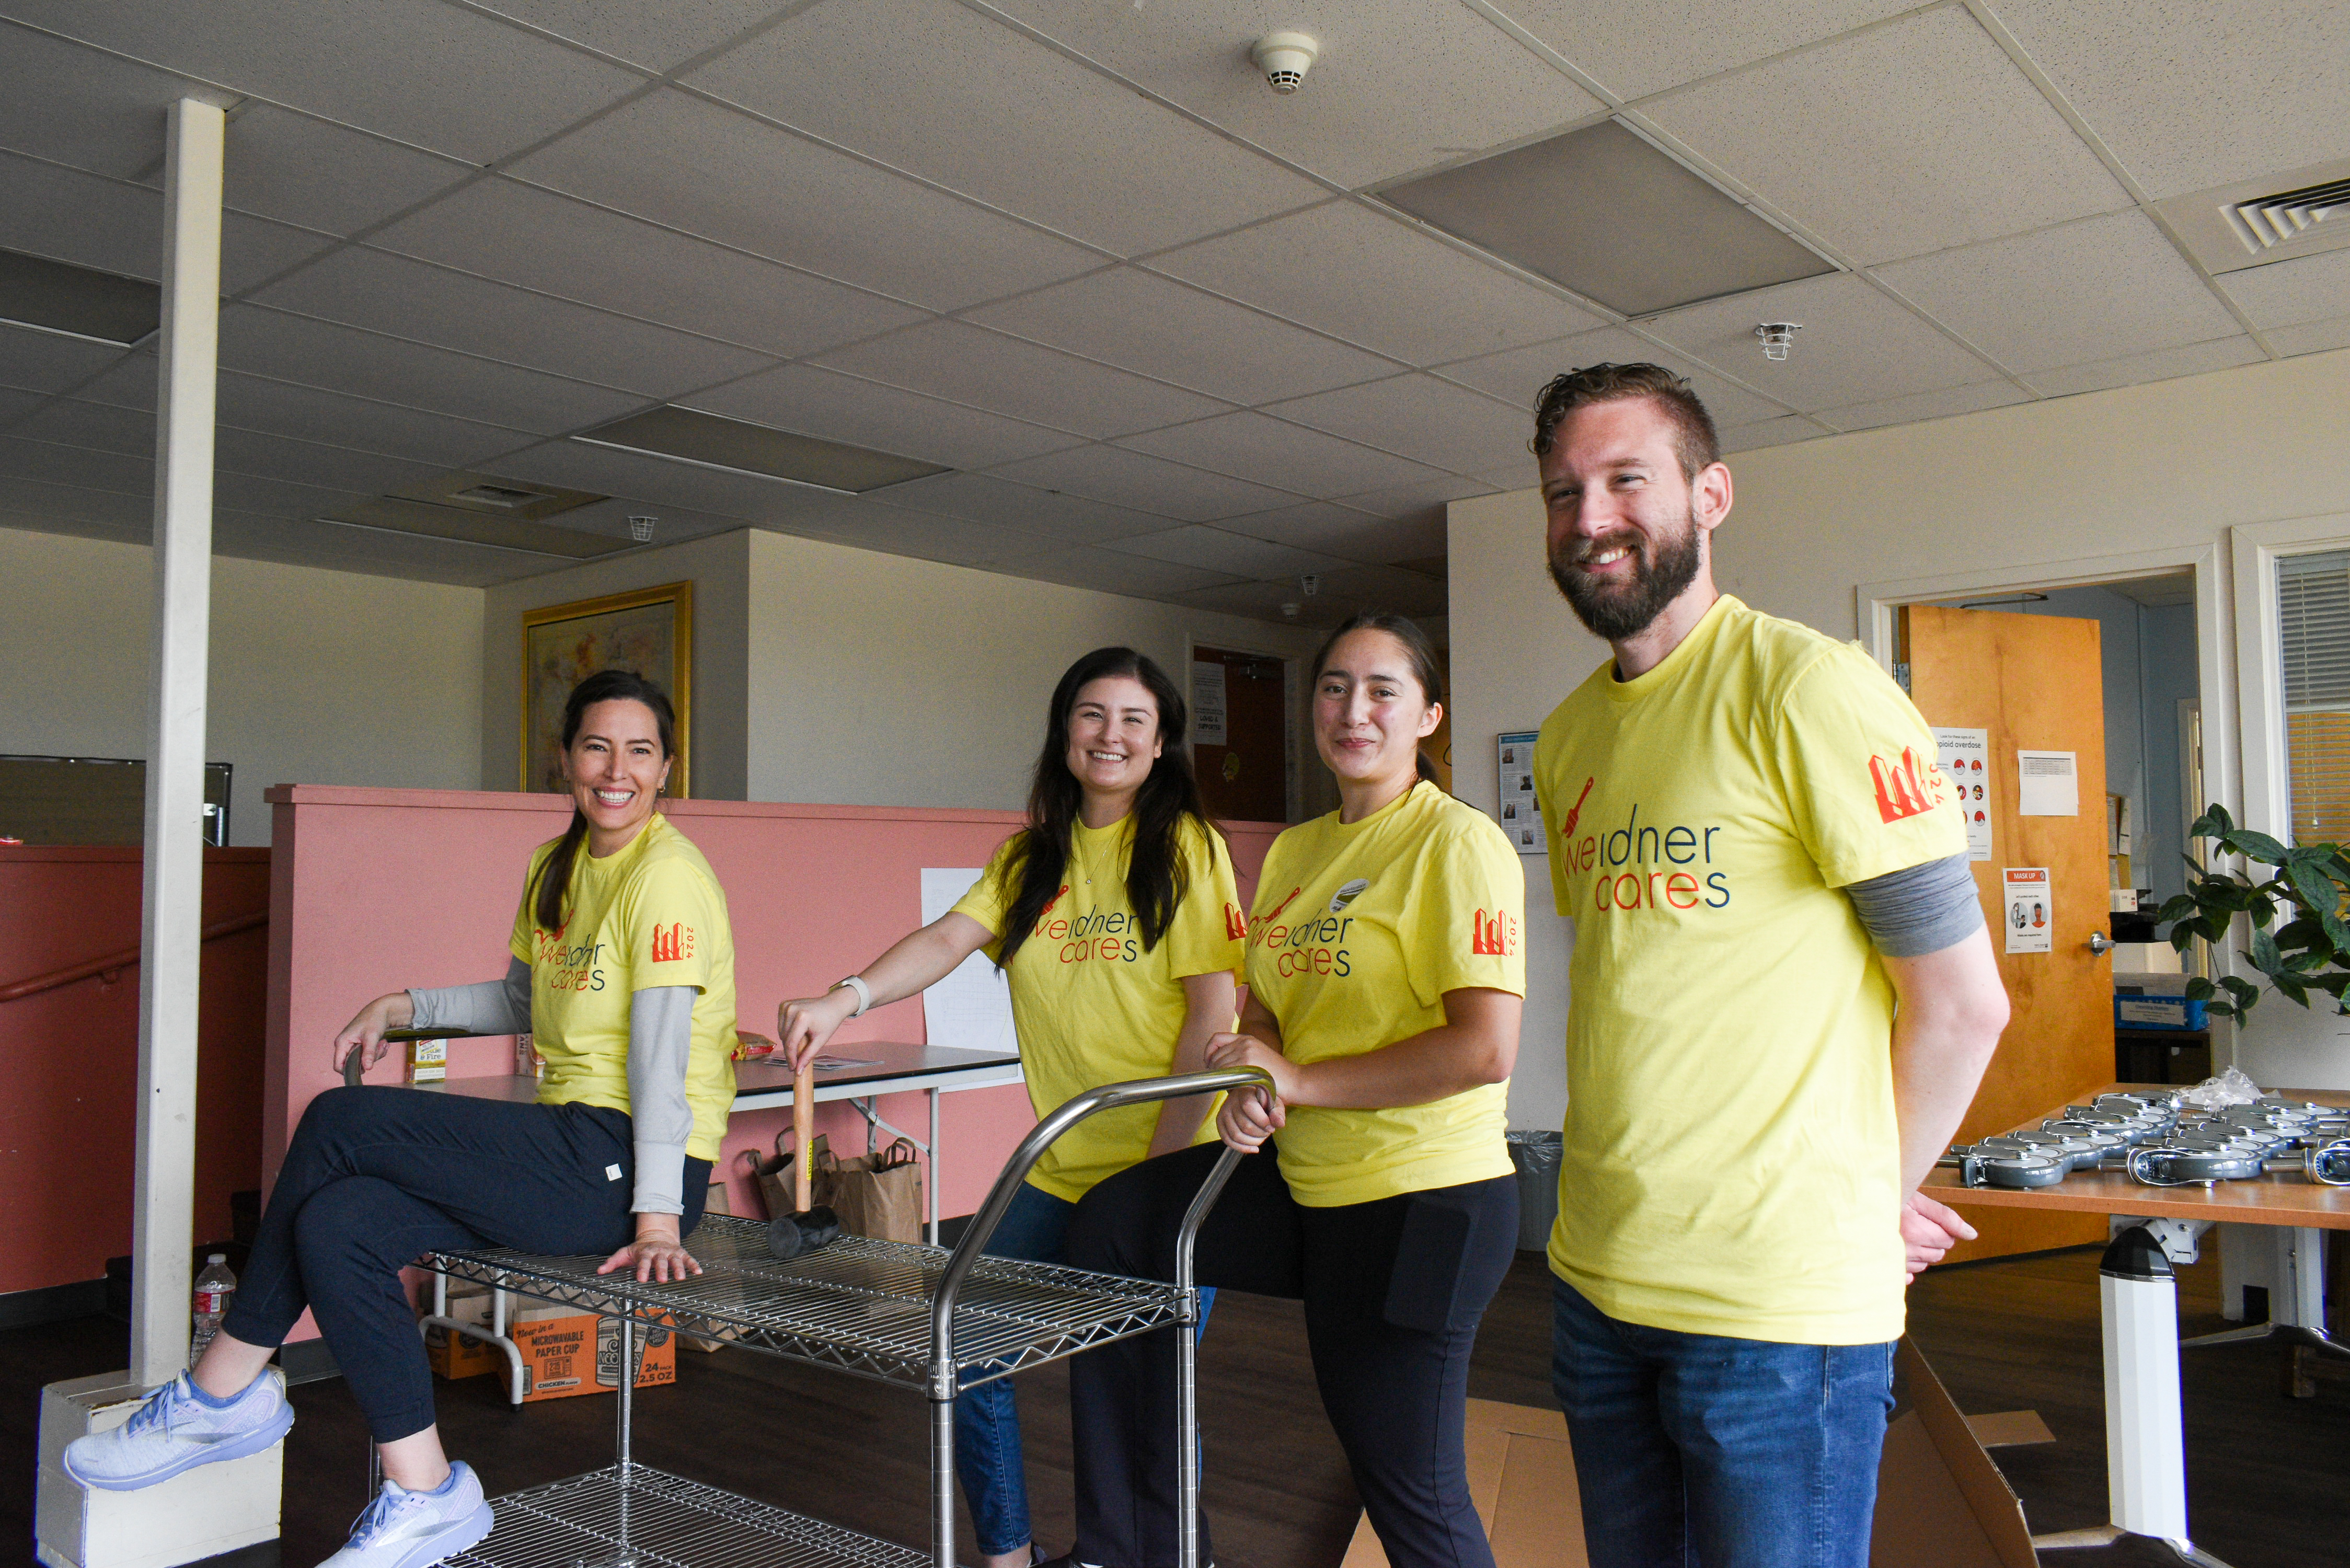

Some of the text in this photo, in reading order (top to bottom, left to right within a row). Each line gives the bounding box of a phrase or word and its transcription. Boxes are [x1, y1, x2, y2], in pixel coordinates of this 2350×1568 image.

[1929, 763, 1944, 805] 024
[1562, 804, 1721, 879] weidner
[1596, 872, 1730, 912] cares
[1059, 938, 1137, 963] cares
[1278, 948, 1351, 978] cares
[517, 1328, 537, 1339] Now
[538, 1325, 546, 1333] in
[532, 1331, 584, 1347] MICROWAVABLE
[536, 1344, 580, 1358] PAPER CUP
[646, 1363, 659, 1372] 24
[538, 1380, 565, 1389] CHICKEN
[639, 1371, 672, 1383] 2.5 OZ
